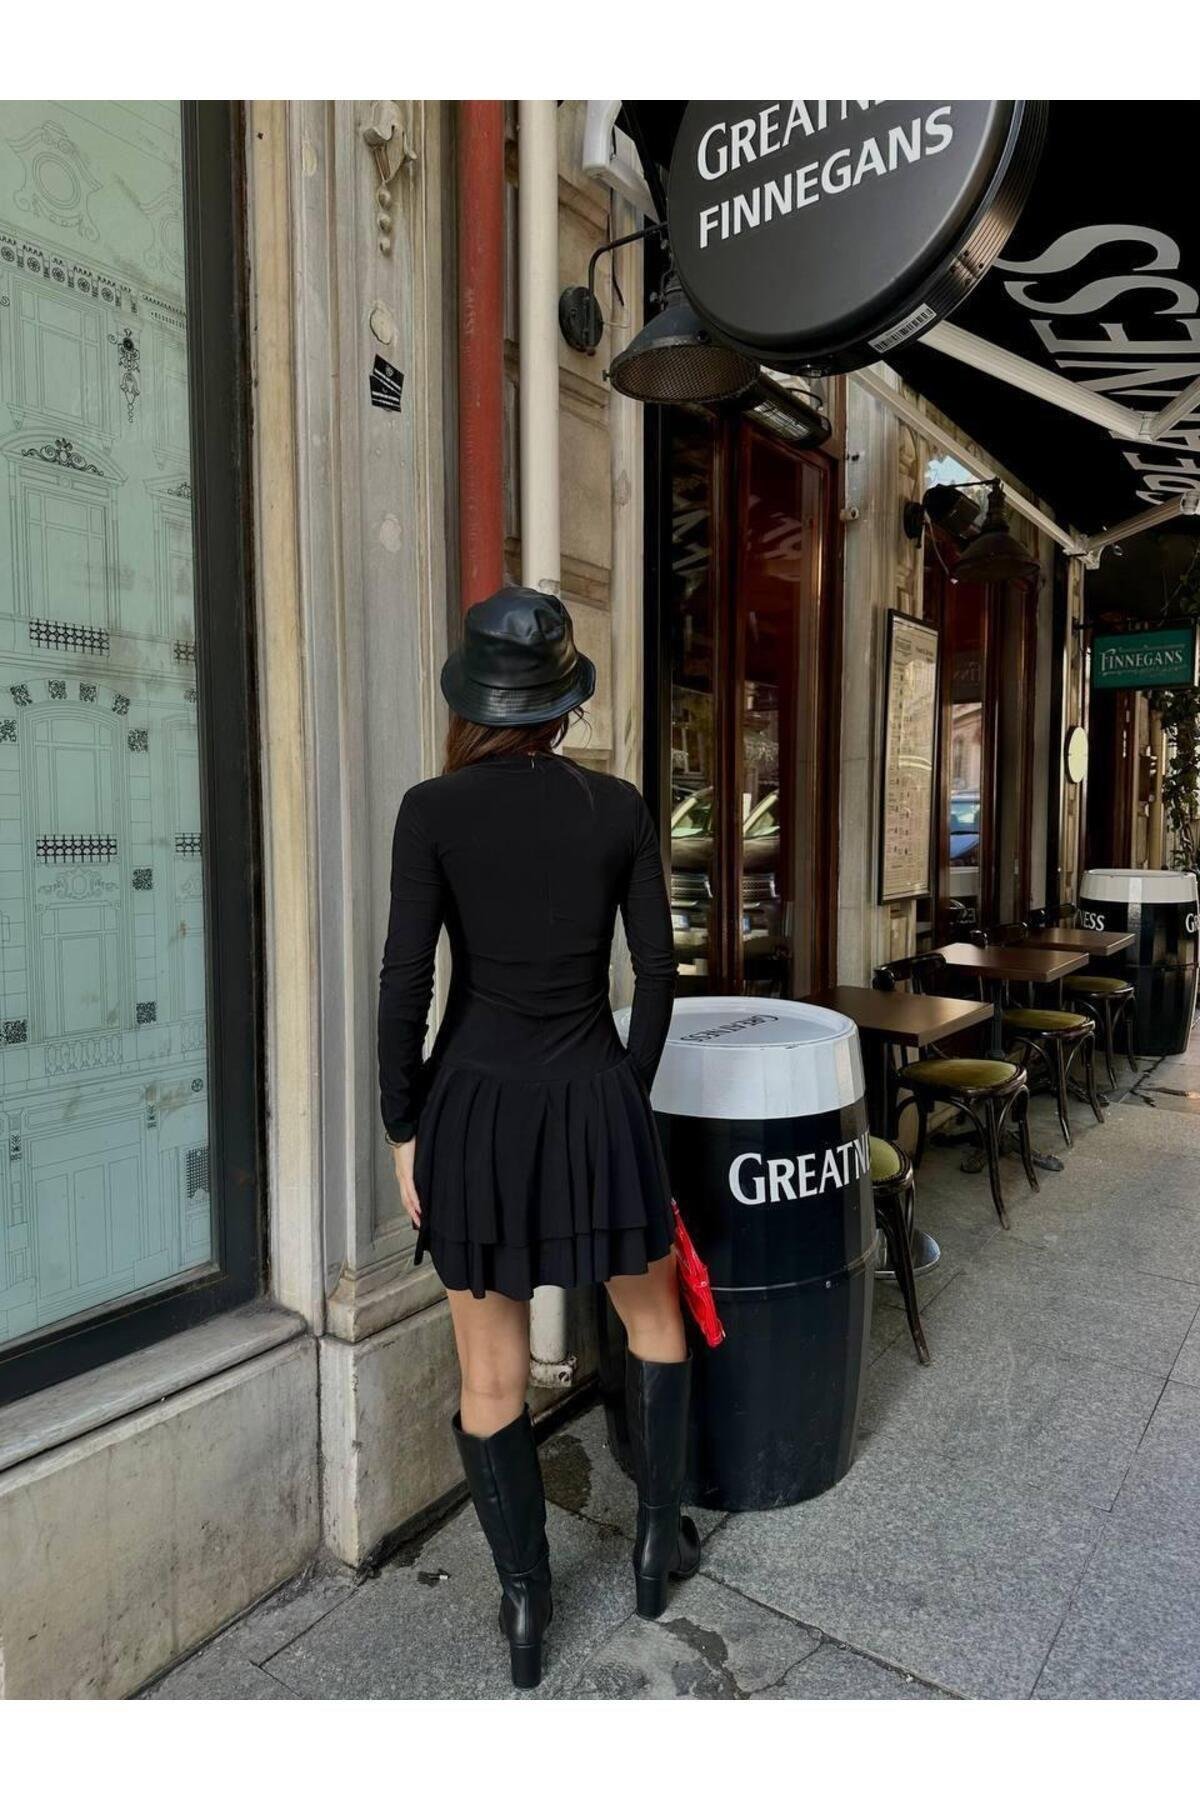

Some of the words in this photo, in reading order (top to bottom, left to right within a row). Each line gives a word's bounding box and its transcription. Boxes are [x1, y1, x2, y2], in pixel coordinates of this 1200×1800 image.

[697, 100, 888, 181] GREA
[699, 105, 954, 249] FINNEGANS
[1101, 648, 1183, 672] FINNEGANS
[728, 1131, 870, 1206] GREATN
